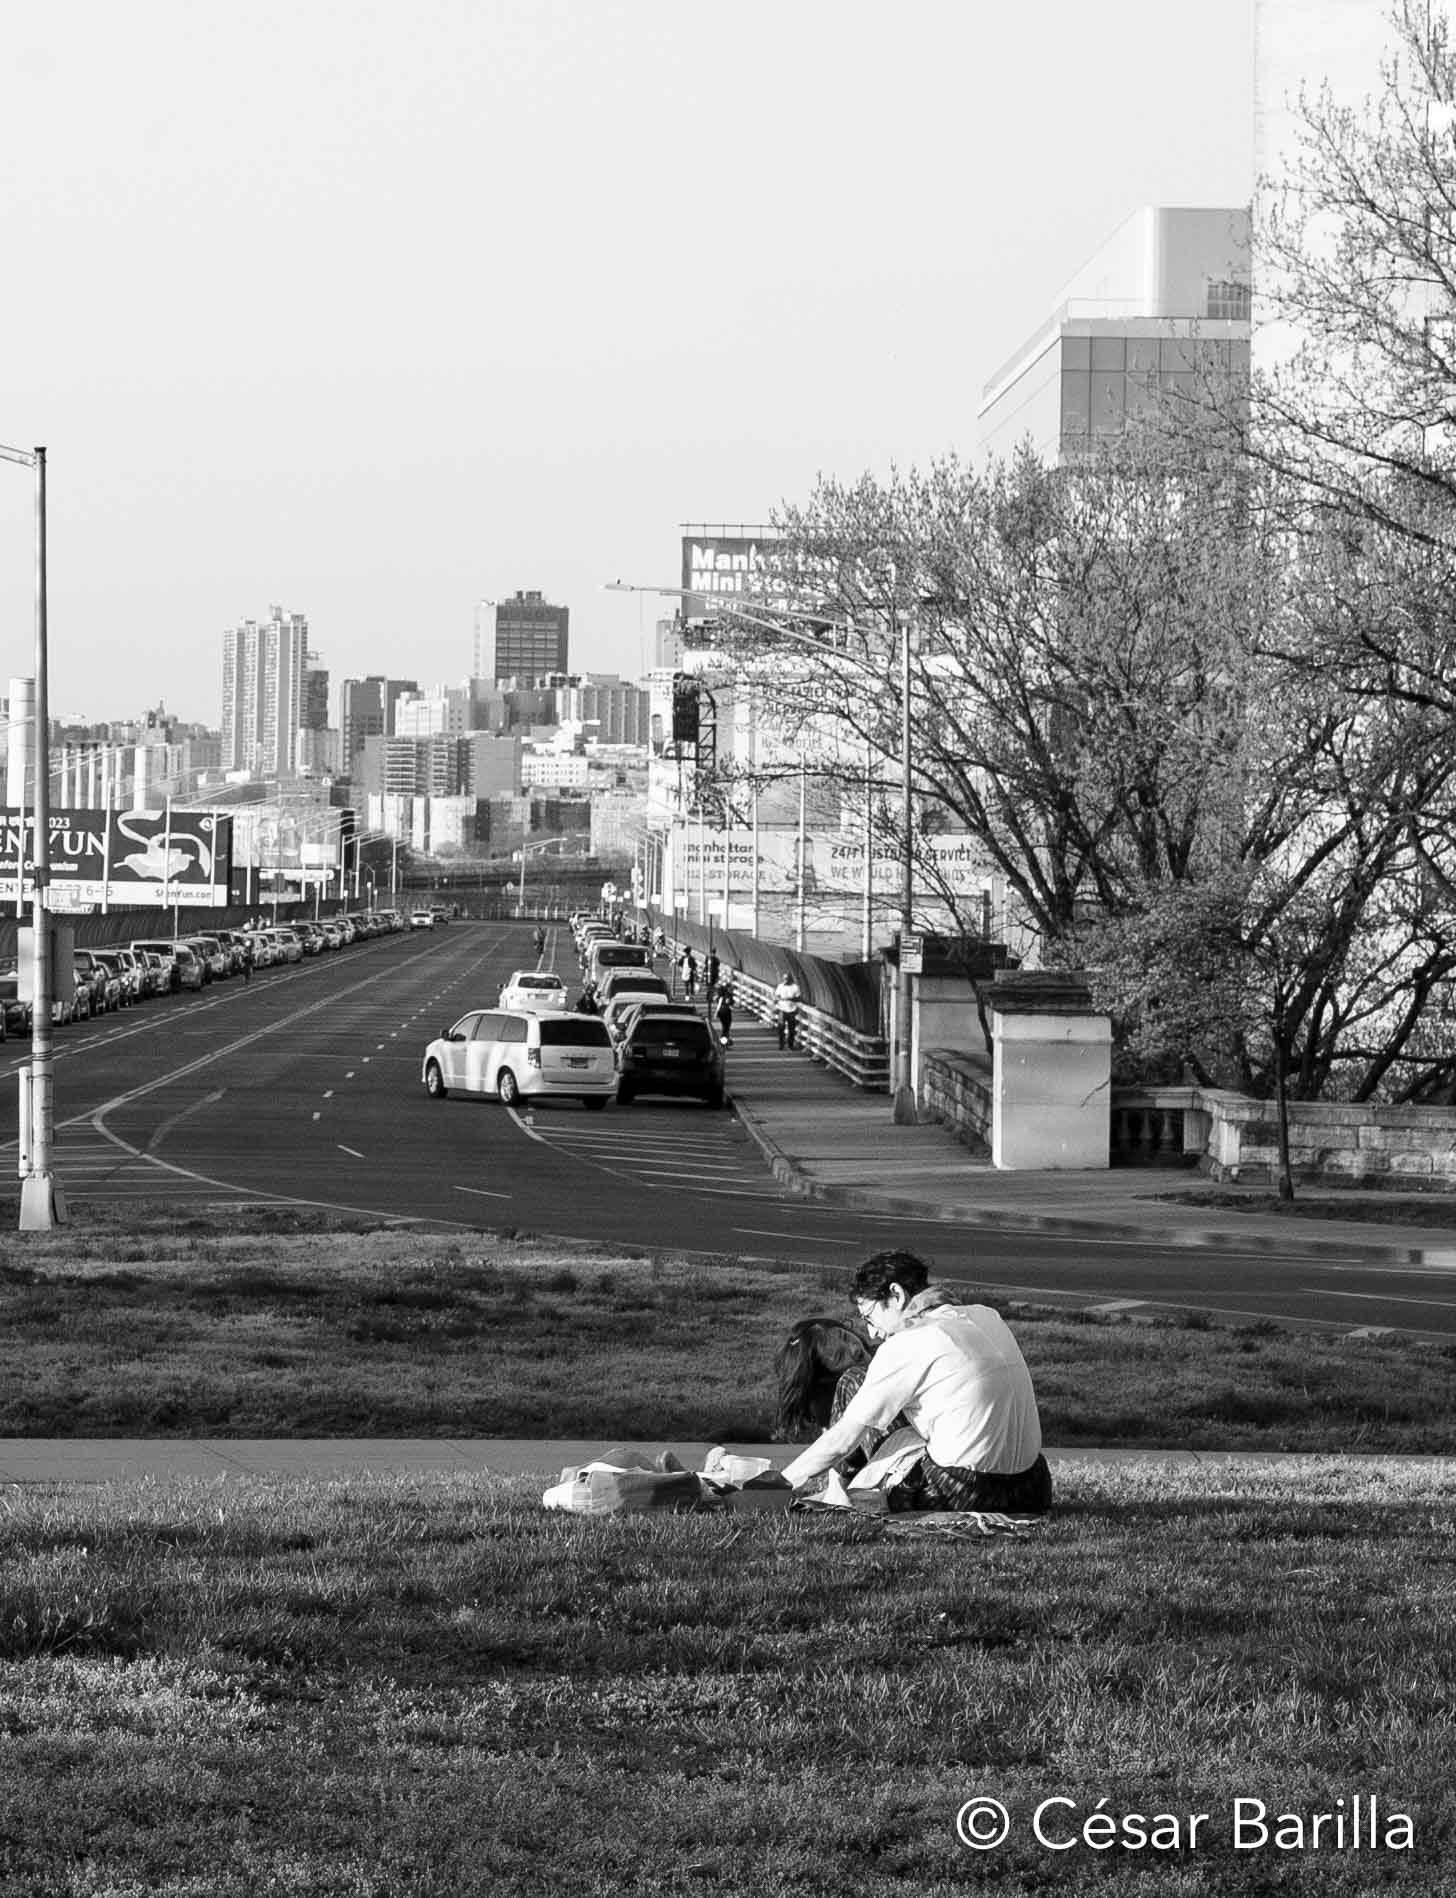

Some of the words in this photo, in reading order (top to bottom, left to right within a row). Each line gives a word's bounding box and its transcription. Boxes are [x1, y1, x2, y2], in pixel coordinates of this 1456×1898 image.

[692, 544, 840, 571] Manhatan
[692, 571, 742, 591] Mini
[48, 816, 71, 829] 023
